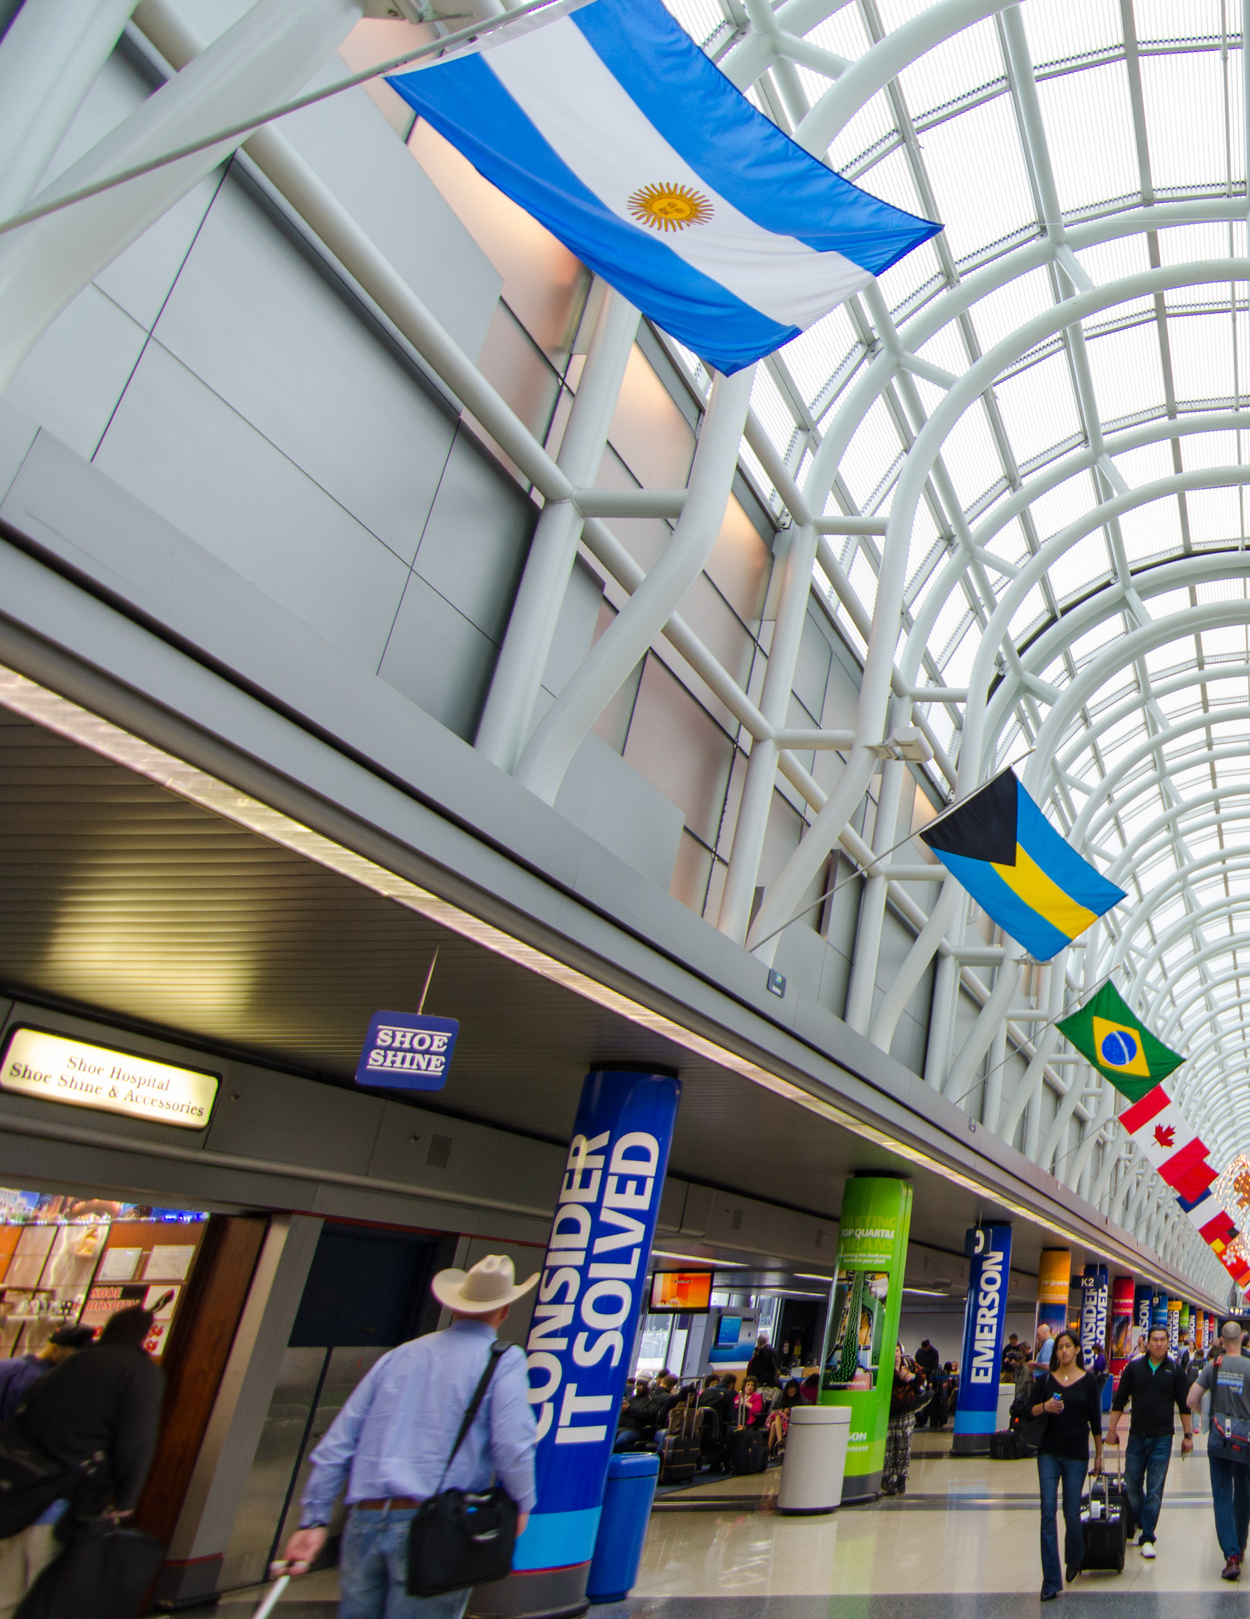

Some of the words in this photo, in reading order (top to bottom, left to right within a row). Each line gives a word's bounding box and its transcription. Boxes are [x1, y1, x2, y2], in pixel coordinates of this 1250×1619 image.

[376, 1029, 449, 1053] SHOE
[67, 1056, 105, 1077] Shoe
[109, 1066, 171, 1092] Hospital
[368, 1049, 446, 1072] SHINE
[9, 1062, 53, 1084] Shoe
[57, 1074, 103, 1095] Shine
[108, 1085, 120, 1098] &
[124, 1090, 205, 1117] Accessories
[573, 1131, 660, 1367] SOLVED
[841, 1229, 854, 1237] TOP
[855, 1229, 895, 1239] QUARTILE
[91, 1287, 123, 1299] SHOE
[1081, 1277, 1094, 1287] K2
[87, 1300, 141, 1311] HOSPIT
[970, 1251, 1003, 1383] EMERSON
[1139, 1300, 1150, 1341] RSON
[555, 1383, 613, 1444] IT
